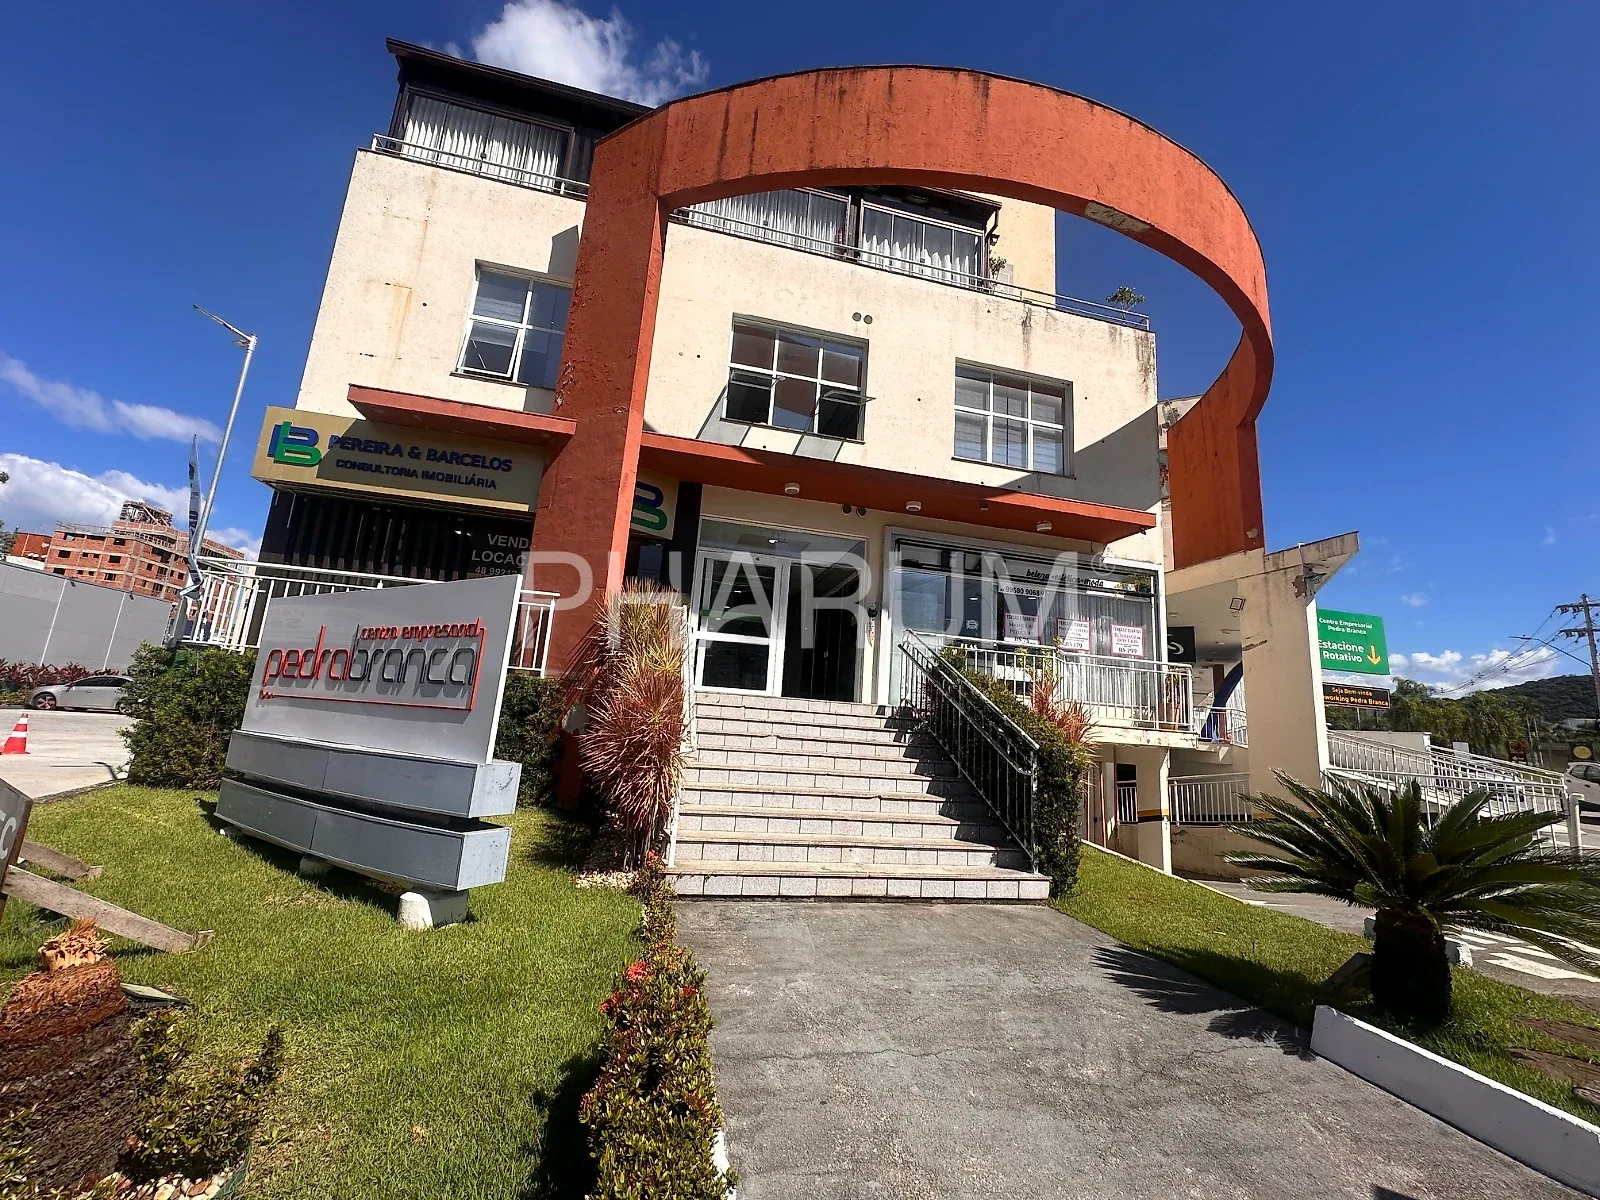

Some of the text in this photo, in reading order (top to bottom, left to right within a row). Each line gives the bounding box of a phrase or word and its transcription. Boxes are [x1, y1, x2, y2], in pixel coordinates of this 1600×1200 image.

[328, 434, 513, 472] PEREIRA & BARCELOS
[335, 458, 497, 489] CONSULTORIA IMOBILIÁRIA
[1318, 617, 1373, 628] Centro Empresarial
[1317, 639, 1364, 652] Estacione
[1323, 650, 1362, 662] Rotativo
[1323, 695, 1389, 706] working Pedra Branca
